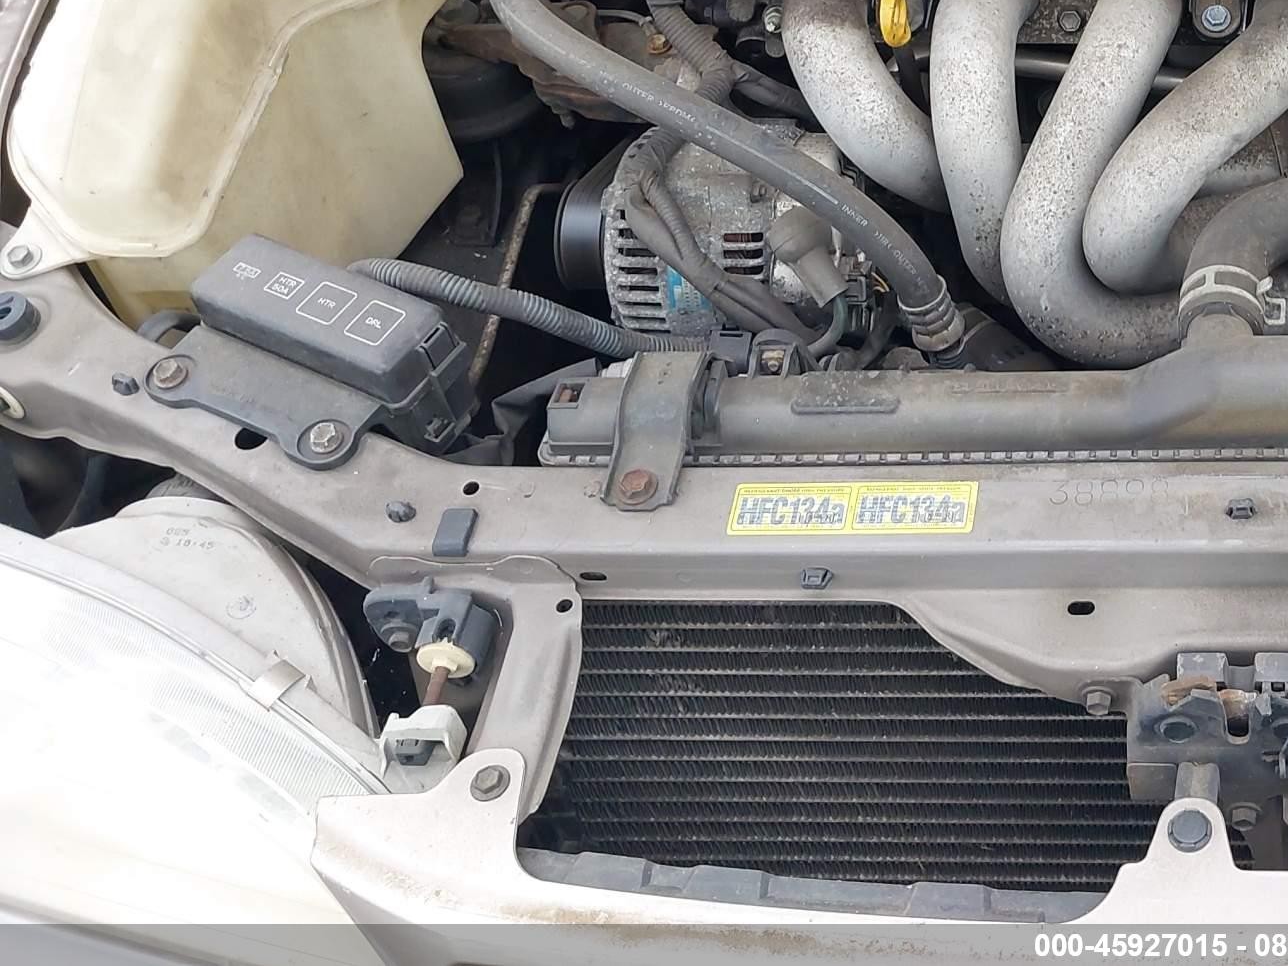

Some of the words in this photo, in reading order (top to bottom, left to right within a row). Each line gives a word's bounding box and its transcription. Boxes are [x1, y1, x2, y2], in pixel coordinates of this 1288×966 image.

[279, 275, 298, 289] HTR
[317, 297, 337, 309] HTR
[364, 316, 383, 329] DRL
[736, 496, 845, 525] HFC134a
[856, 494, 966, 524] HFC134a
